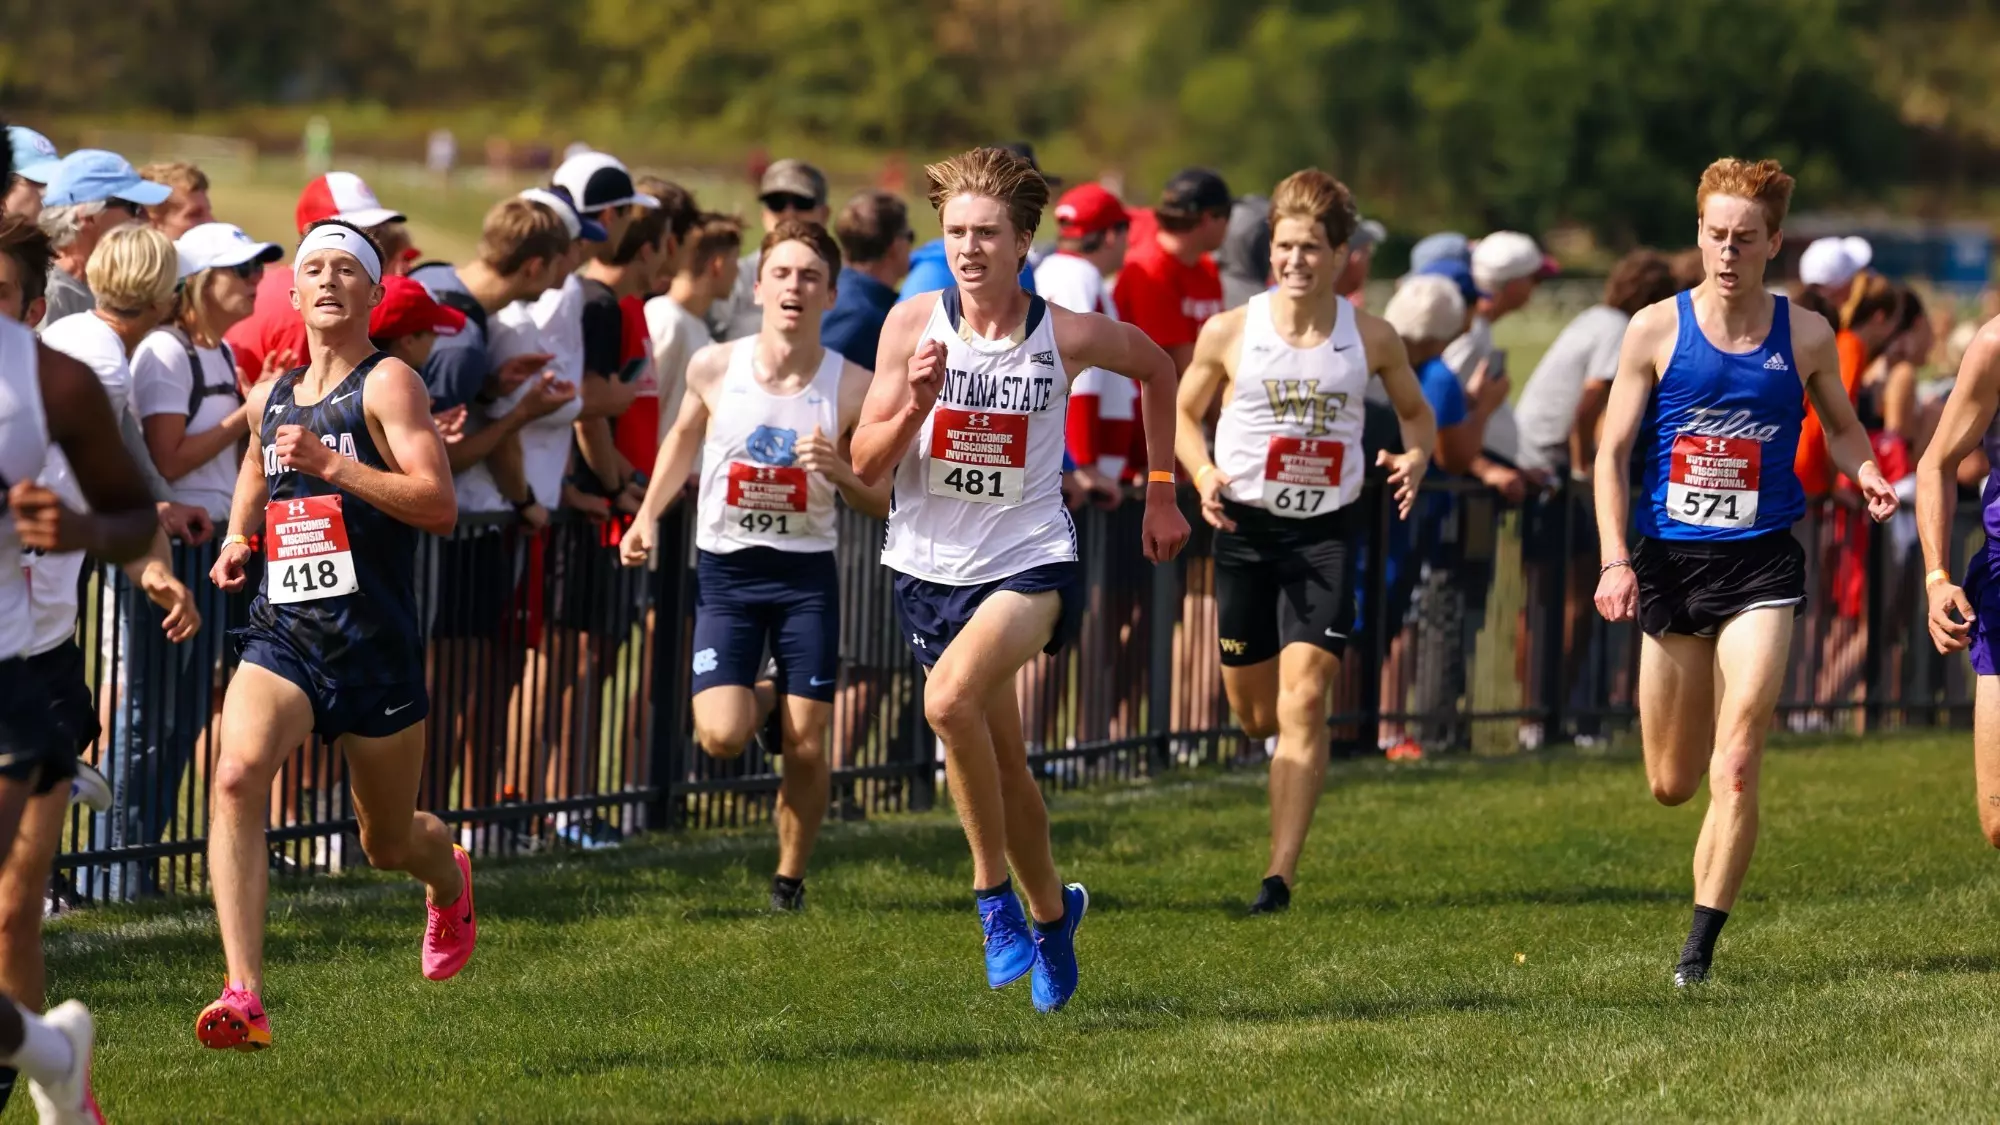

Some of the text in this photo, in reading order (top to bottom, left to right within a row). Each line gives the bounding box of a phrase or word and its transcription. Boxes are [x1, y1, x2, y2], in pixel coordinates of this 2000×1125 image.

[1763, 361, 1789, 371] adidas
[939, 367, 1053, 412] NTANA STATE
[1262, 379, 1348, 437] WF
[1677, 406, 1781, 442] Tulsa
[946, 429, 1013, 444] NUTTYCOMBE
[952, 439, 1003, 454] WISCONSIN
[945, 449, 1012, 465] INVITATIONAL
[1685, 454, 1749, 469] NUTTYCOMBE
[1690, 465, 1739, 477] WISCONSIN
[944, 467, 1005, 497] 481
[1684, 474, 1747, 489] INVITATIONAL
[1275, 487, 1325, 513] 617
[1682, 491, 1740, 520] 571
[275, 517, 332, 536] NUTTYCOMBE
[739, 513, 790, 535] 491
[280, 530, 326, 546] WISCONSIN
[277, 540, 337, 559] INVITATIONAL
[282, 559, 338, 593] 418
